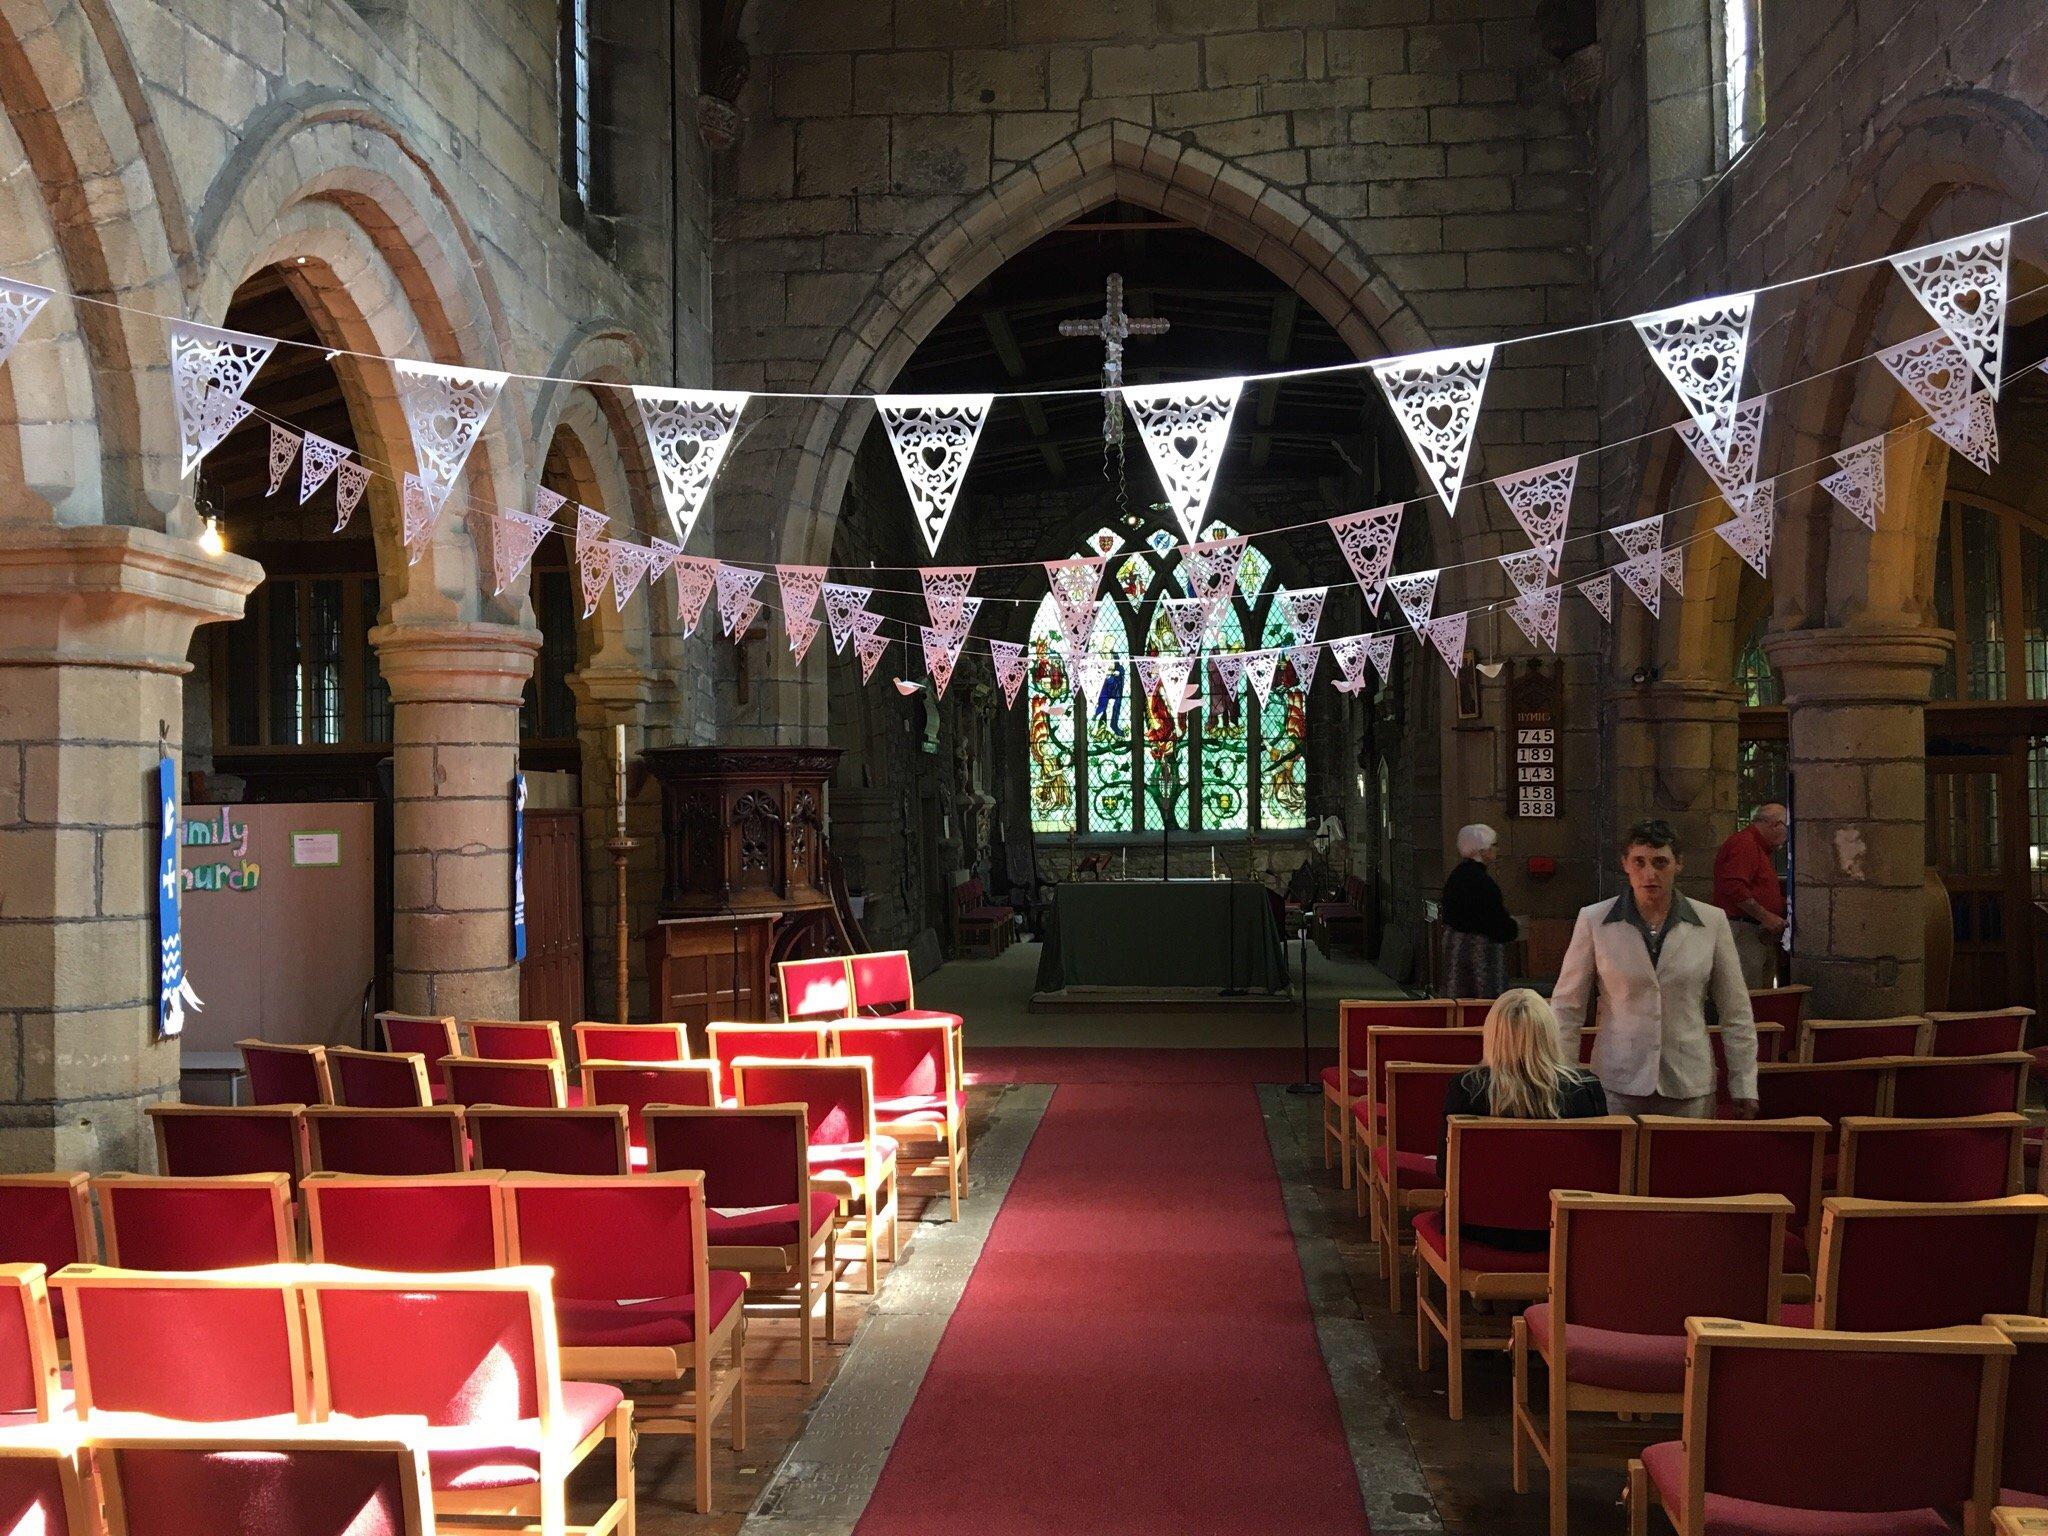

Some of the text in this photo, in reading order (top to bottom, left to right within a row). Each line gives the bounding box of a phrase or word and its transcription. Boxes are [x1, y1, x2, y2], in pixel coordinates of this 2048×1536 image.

[1518, 712, 1551, 721] HYMNS
[1520, 730, 1552, 743] 745
[1520, 749, 1551, 761] 189
[1520, 768, 1552, 780] 143
[1522, 786, 1552, 800] 158
[1521, 802, 1553, 815] 388
[181, 806, 249, 857] mily
